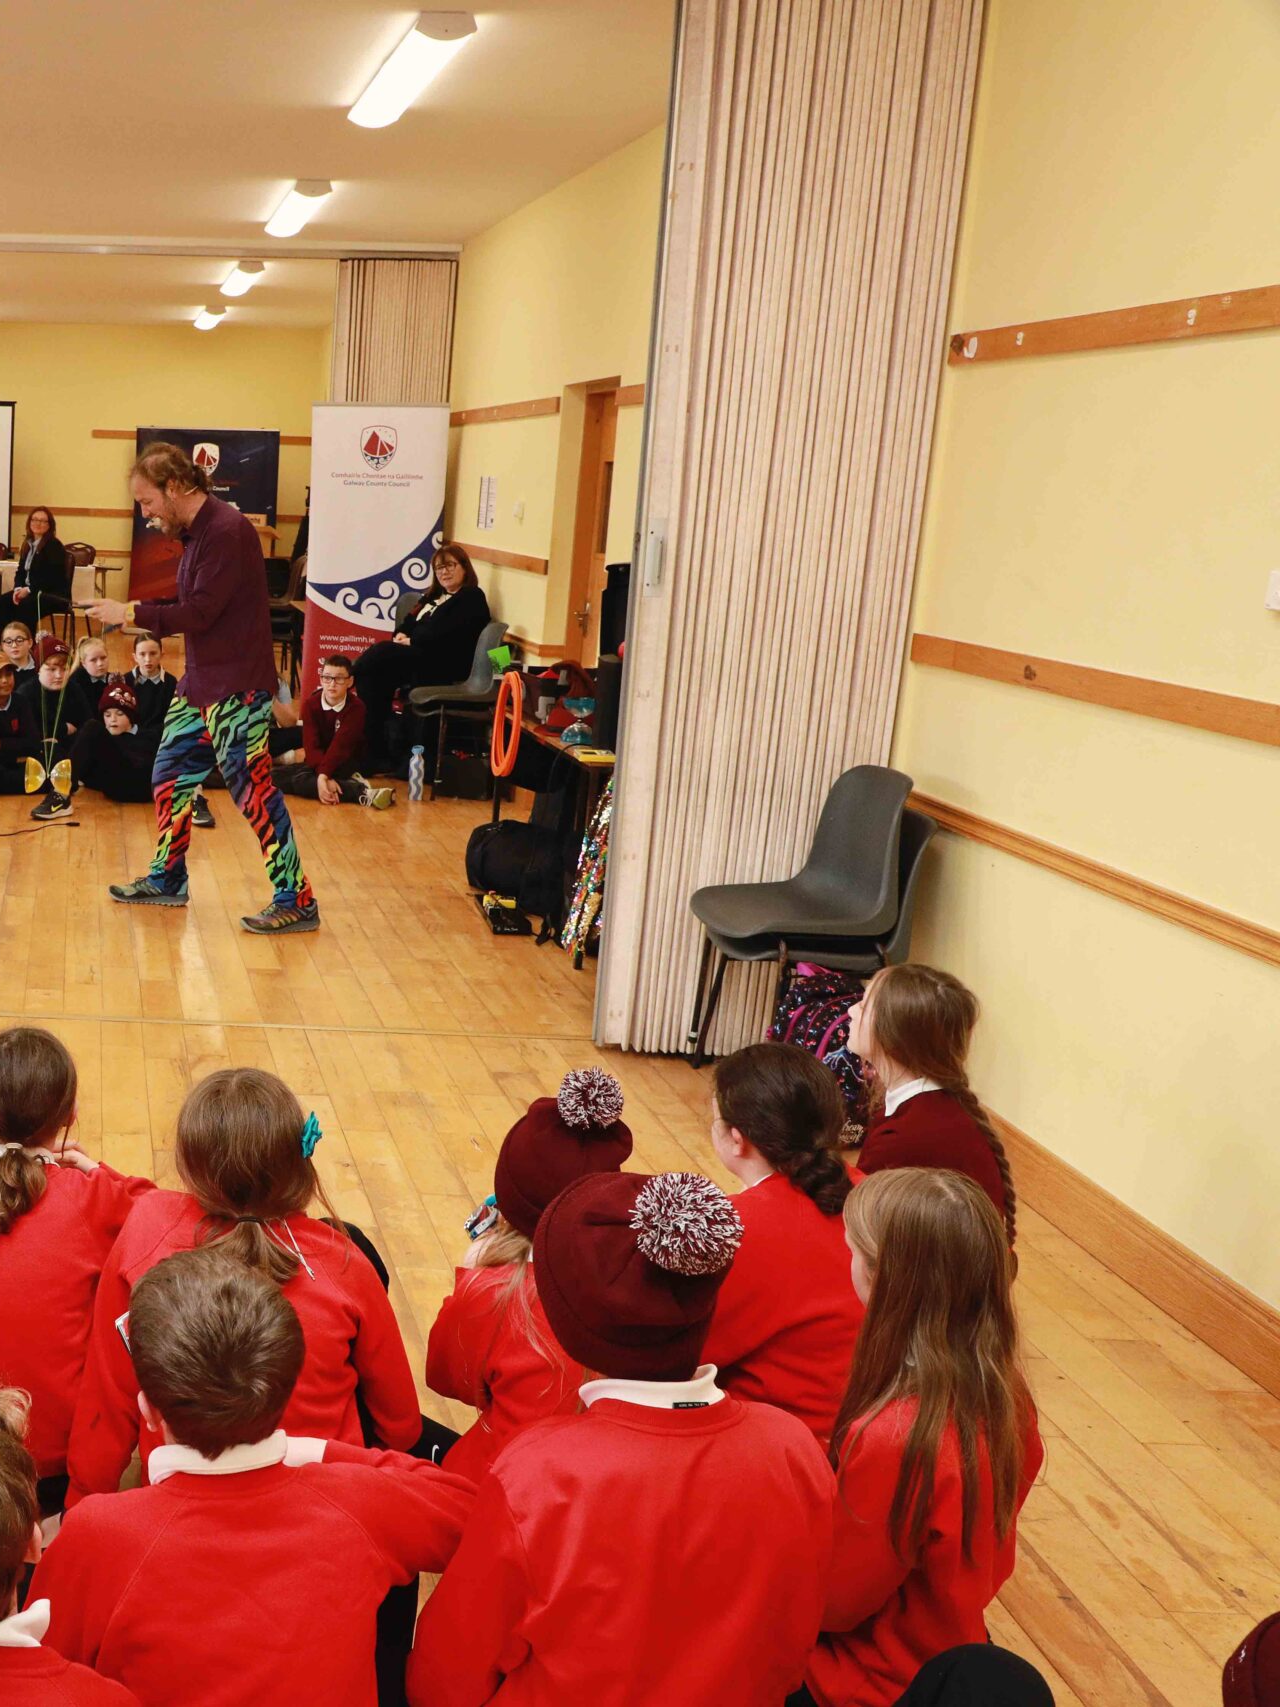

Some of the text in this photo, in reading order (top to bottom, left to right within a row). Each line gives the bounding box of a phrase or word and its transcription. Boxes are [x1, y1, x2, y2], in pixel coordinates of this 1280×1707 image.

[366, 480, 387, 488] County
[319, 634, 376, 644] www.gaillimh.ie
[319, 644, 369, 653] www.galway.i
